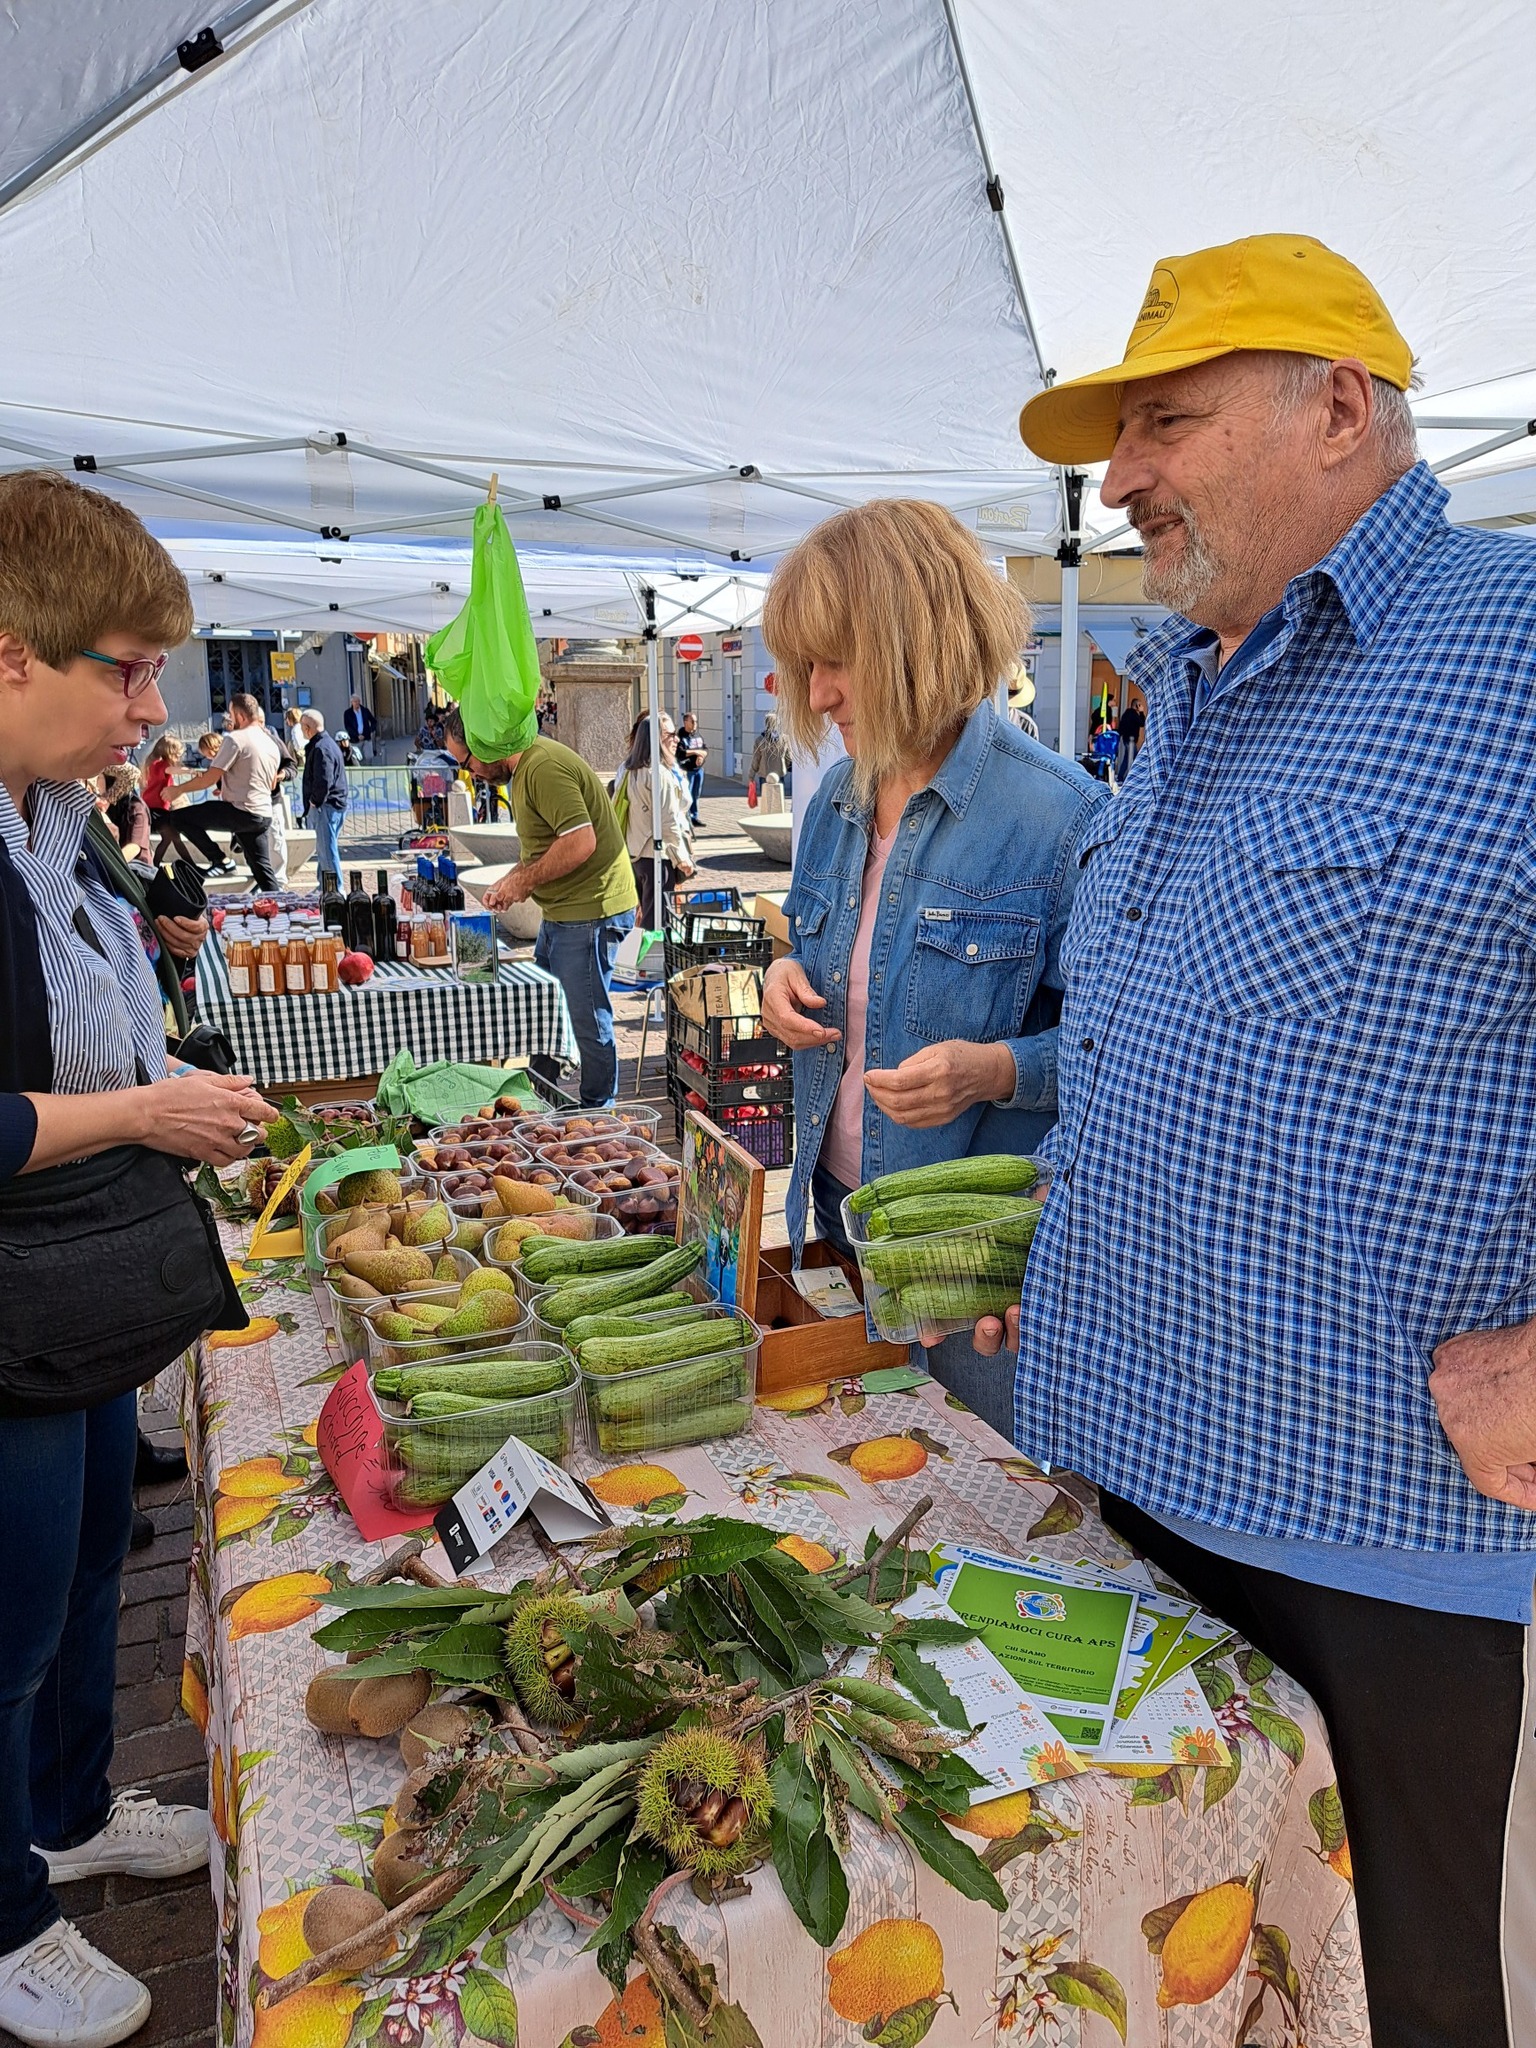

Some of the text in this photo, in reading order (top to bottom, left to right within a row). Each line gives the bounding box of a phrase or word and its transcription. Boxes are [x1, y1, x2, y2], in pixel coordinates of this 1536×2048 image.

[828, 1282, 847, 1290] 5
[487, 1467, 497, 1480] VISA
[1045, 1631, 1083, 1645] CURA
[1087, 1638, 1117, 1648] APS
[1004, 1644, 1047, 1658] CHI SIAMO
[998, 1652, 1027, 1664] AZIONI
[1028, 1658, 1044, 1667] SUL
[1045, 1662, 1096, 1676] TERRITORIO
